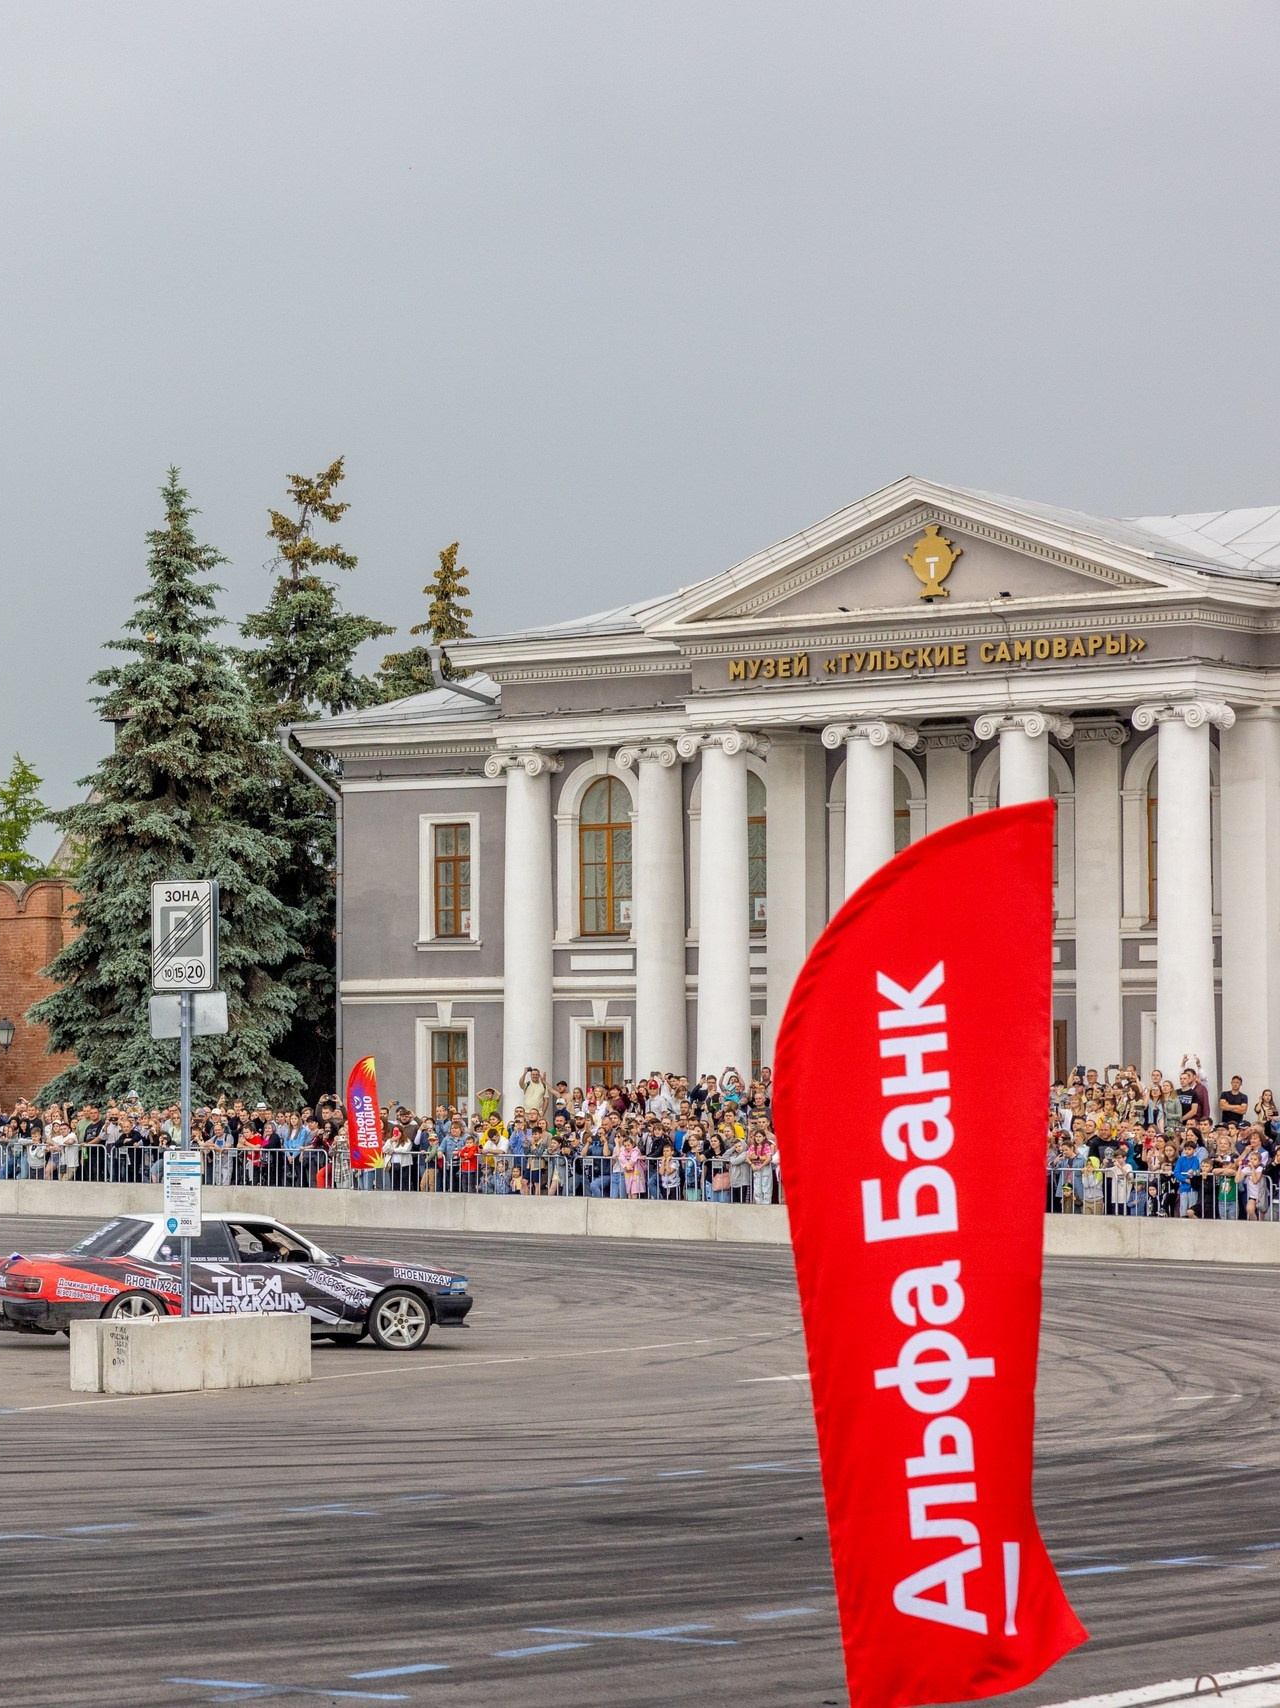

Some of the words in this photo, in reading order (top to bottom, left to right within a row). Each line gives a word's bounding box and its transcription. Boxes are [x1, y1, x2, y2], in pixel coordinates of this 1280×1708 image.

[728, 652, 809, 681] МУЗЕЙ
[822, 644, 968, 674] «ТУЛЬСКИЕ
[979, 633, 1147, 663] САМОВАРЫ»
[164, 890, 200, 902] ЗОНА
[164, 968, 172, 978] 10
[174, 967, 184, 979] 15
[187, 965, 203, 979] 20
[862, 960, 959, 1245] Банк
[355, 1111, 368, 1149] АЛЬФА
[363, 1095, 379, 1149] ВЫГОДНО
[393, 1267, 452, 1287] PHOENIX24V
[192, 1292, 307, 1314] UNDERGROUND
[874, 1259, 996, 1637] Альфа
